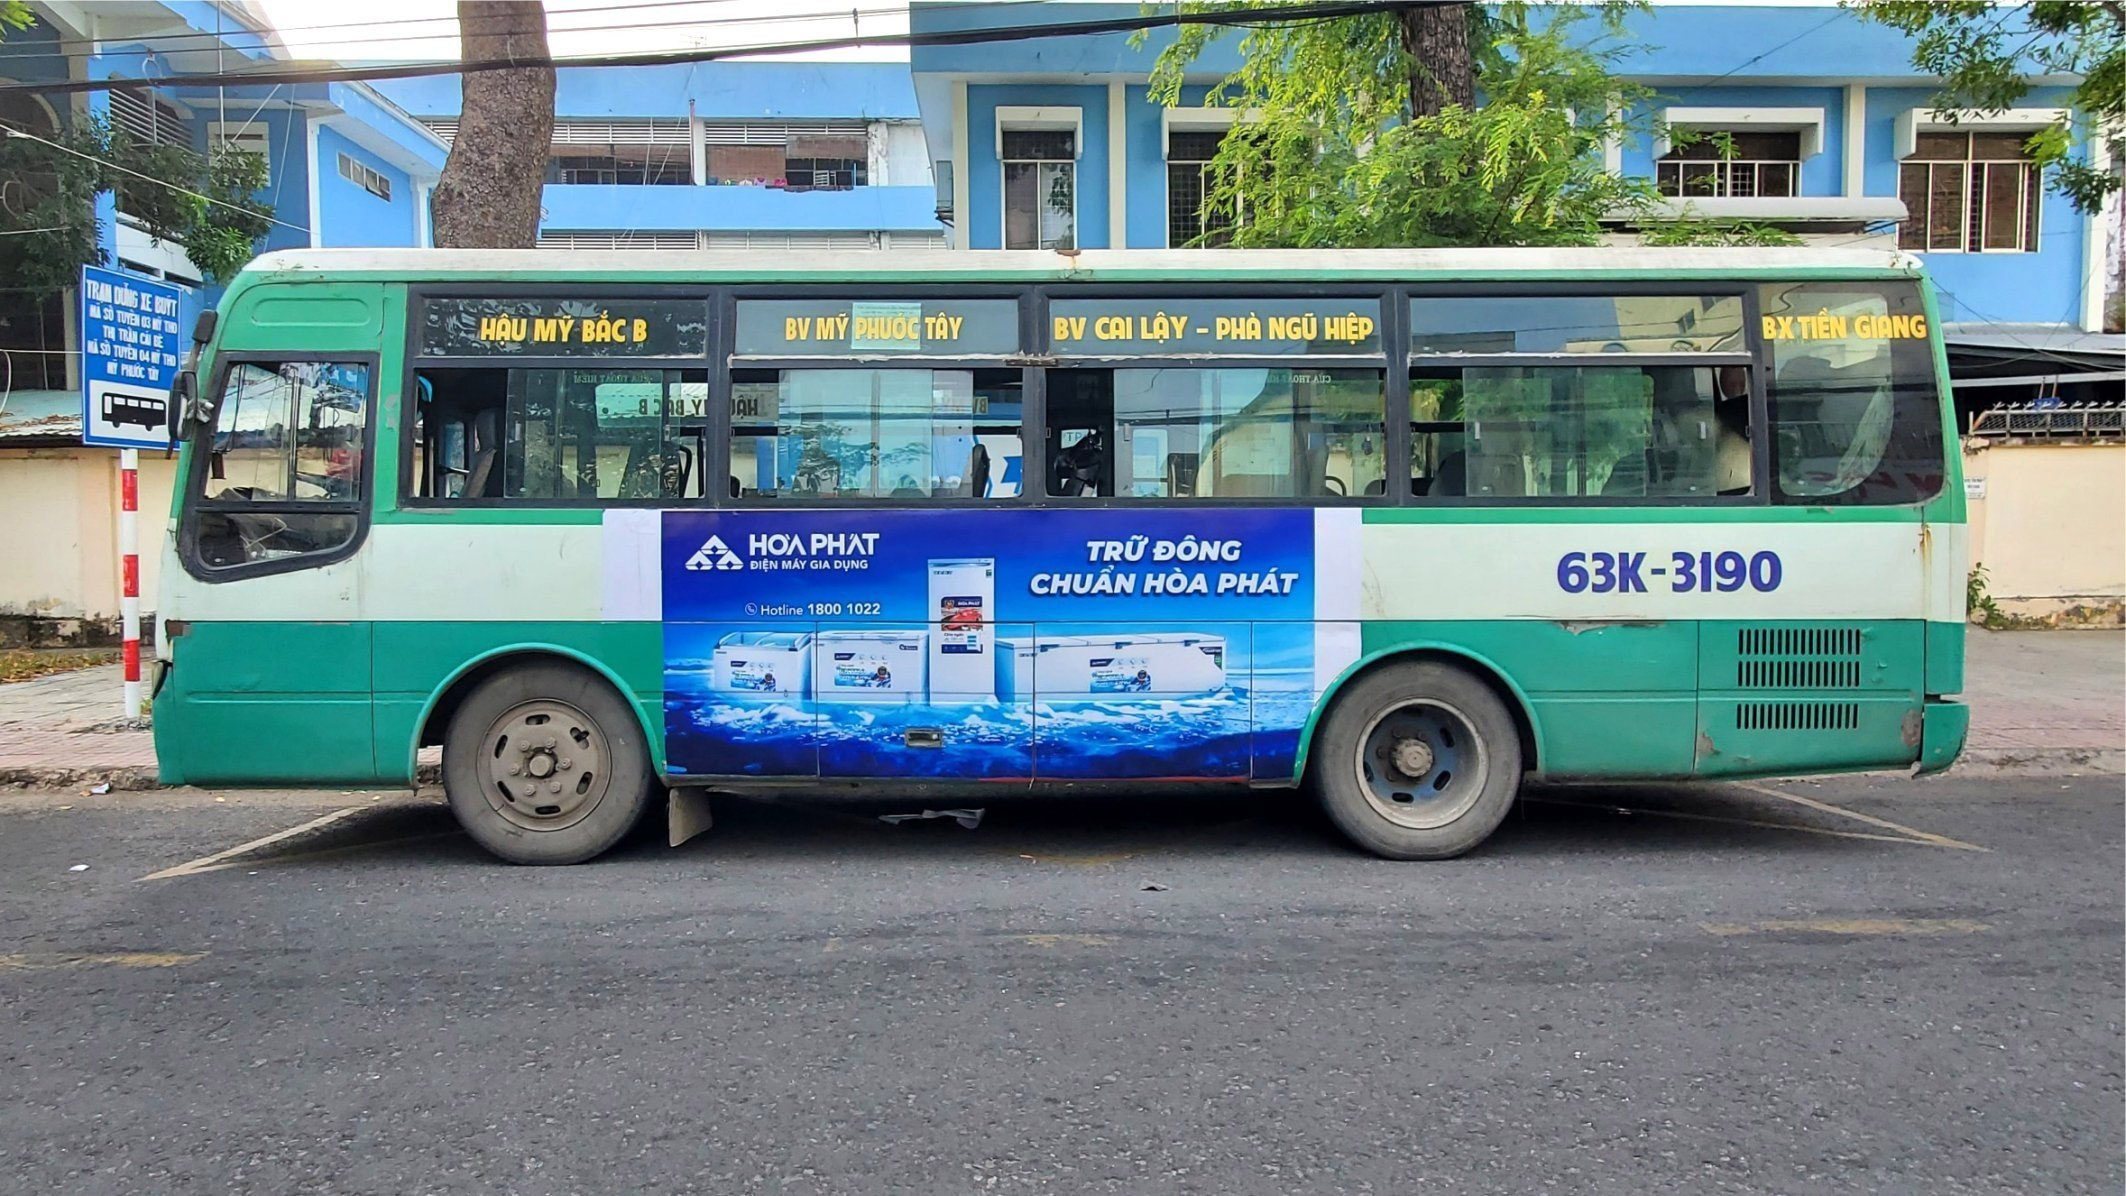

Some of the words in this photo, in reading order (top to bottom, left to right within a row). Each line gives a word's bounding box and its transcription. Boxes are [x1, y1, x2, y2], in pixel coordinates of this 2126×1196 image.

[140, 292, 153, 312] XE
[141, 316, 151, 329] 03
[164, 320, 177, 334] THO
[480, 313, 527, 346] HẬU
[533, 315, 575, 343] MỸ
[581, 310, 626, 343] BẮC
[632, 319, 647, 343] B
[785, 317, 812, 341] BV
[816, 313, 850, 340] MỸ
[924, 312, 963, 340] TÂY
[1054, 317, 1086, 341] BV
[1094, 317, 1133, 340] CAI
[1140, 312, 1188, 344] LẬY
[1216, 313, 1262, 340] PHÀ
[1268, 313, 1318, 340] NGŨ
[1324, 312, 1374, 345] HIỆP
[1761, 315, 1795, 340] BX
[1797, 307, 1848, 340] TIỀN
[1854, 314, 1928, 340] GIANG
[139, 350, 150, 362] 04
[162, 353, 177, 367] THO
[749, 533, 807, 556] HÒA
[810, 533, 880, 556] PHÁT
[1087, 535, 1149, 561] TRỮ
[1153, 535, 1242, 561] ĐÔNG
[750, 558, 778, 572] ĐIỆN
[782, 558, 807, 570] MÁY
[810, 560, 831, 570] GIA
[834, 560, 868, 572] DỤNG
[1557, 551, 1782, 594] 63K-3190
[1031, 565, 1136, 594] CHUẨN
[1143, 568, 1208, 593] HÒA
[1217, 568, 1298, 593] PHÁT
[761, 604, 803, 616] Hotline
[808, 604, 841, 615] 1800
[847, 604, 880, 615] 1022
